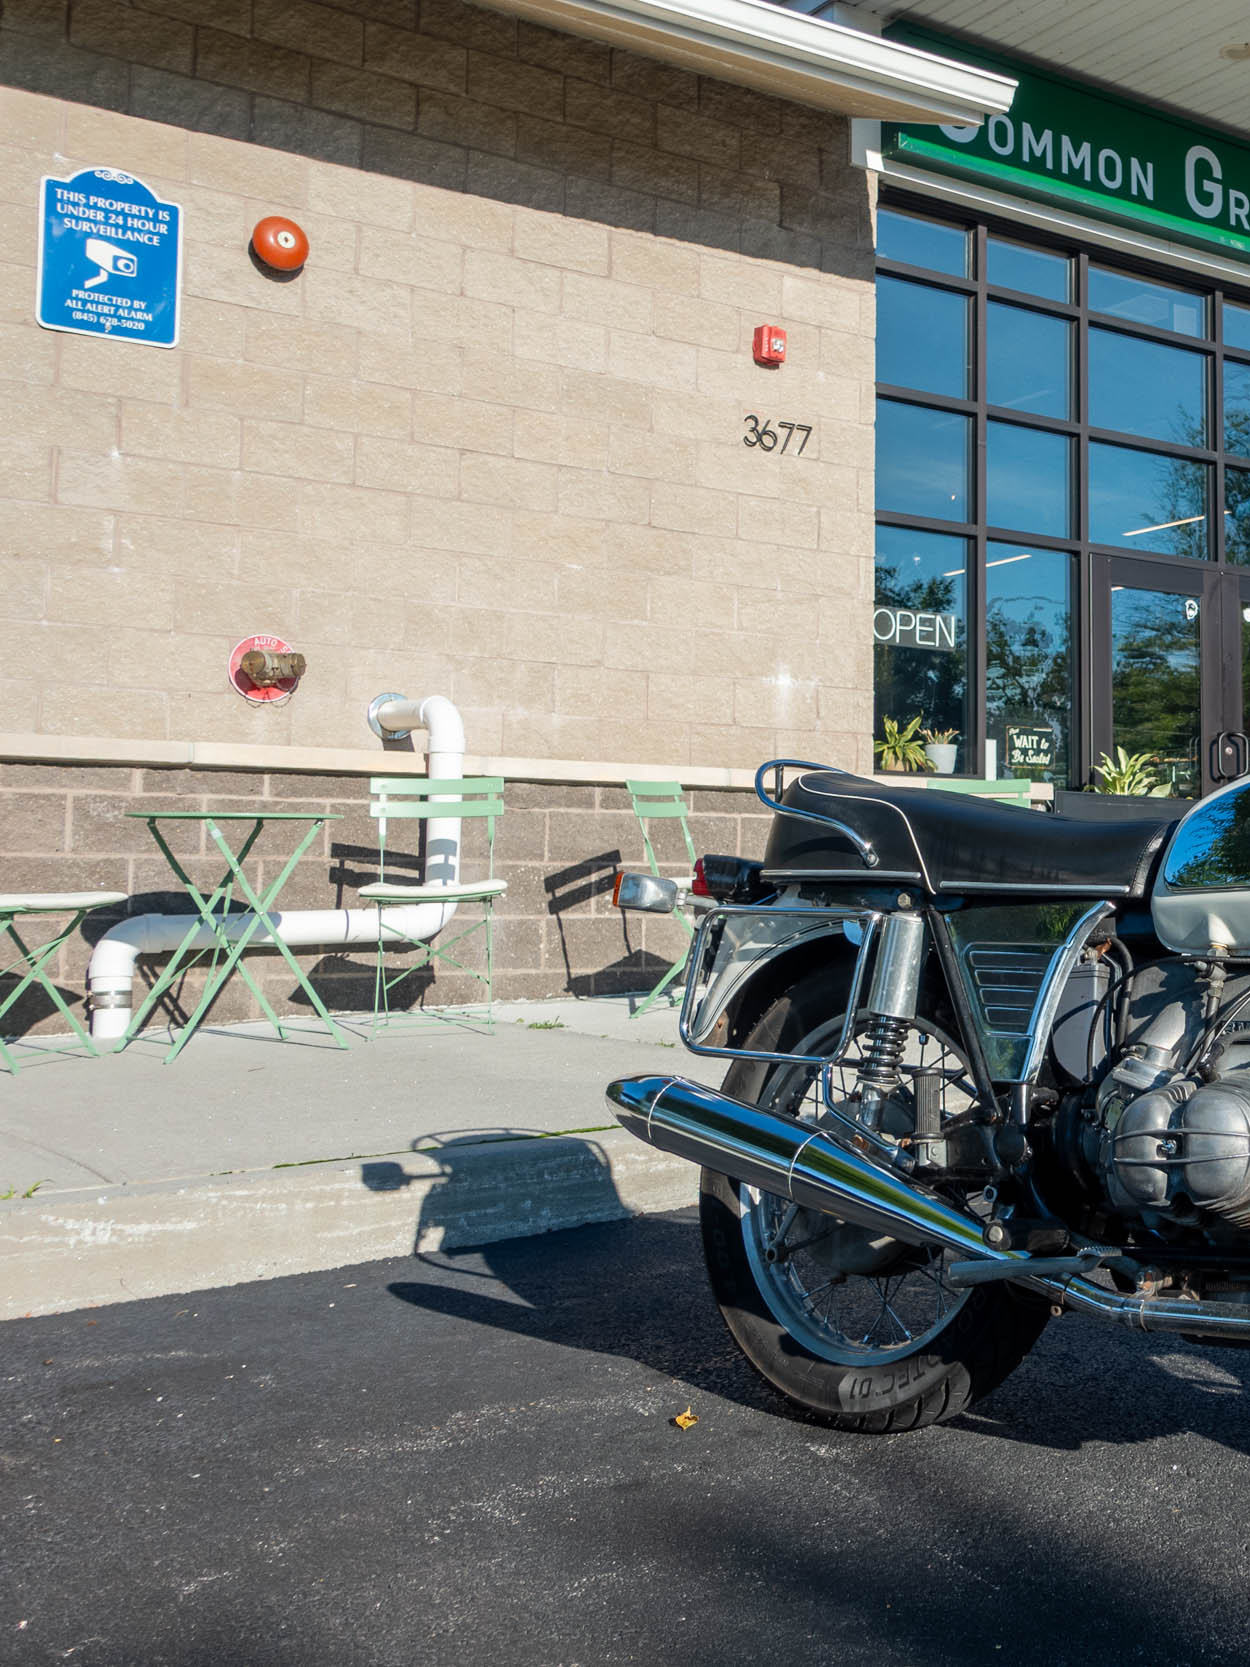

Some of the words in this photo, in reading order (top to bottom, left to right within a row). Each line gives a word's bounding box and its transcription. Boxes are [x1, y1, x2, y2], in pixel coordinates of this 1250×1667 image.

[55, 188, 87, 204] THIS
[89, 195, 155, 218] PROPERTY
[158, 210, 170, 221] IS
[57, 202, 105, 222] UNDER
[108, 213, 124, 225] 24
[127, 217, 168, 234] HOUR
[64, 218, 160, 246] SURVEILLANCE
[64, 299, 83, 309] ALL
[85, 302, 116, 315] ALERT
[117, 308, 152, 321] ALARM
[72, 289, 131, 307] PROTECTED
[133, 300, 147, 310] BY
[72, 310, 97, 323] (845)
[99, 316, 145, 330] 628-5020
[743, 415, 813, 455] 3677
[873, 608, 955, 647] OPEN
[254, 637, 279, 648] AUTO
[1013, 735, 1039, 749] WAIT
[1040, 738, 1050, 750] to
[1011, 749, 1025, 763] Be
